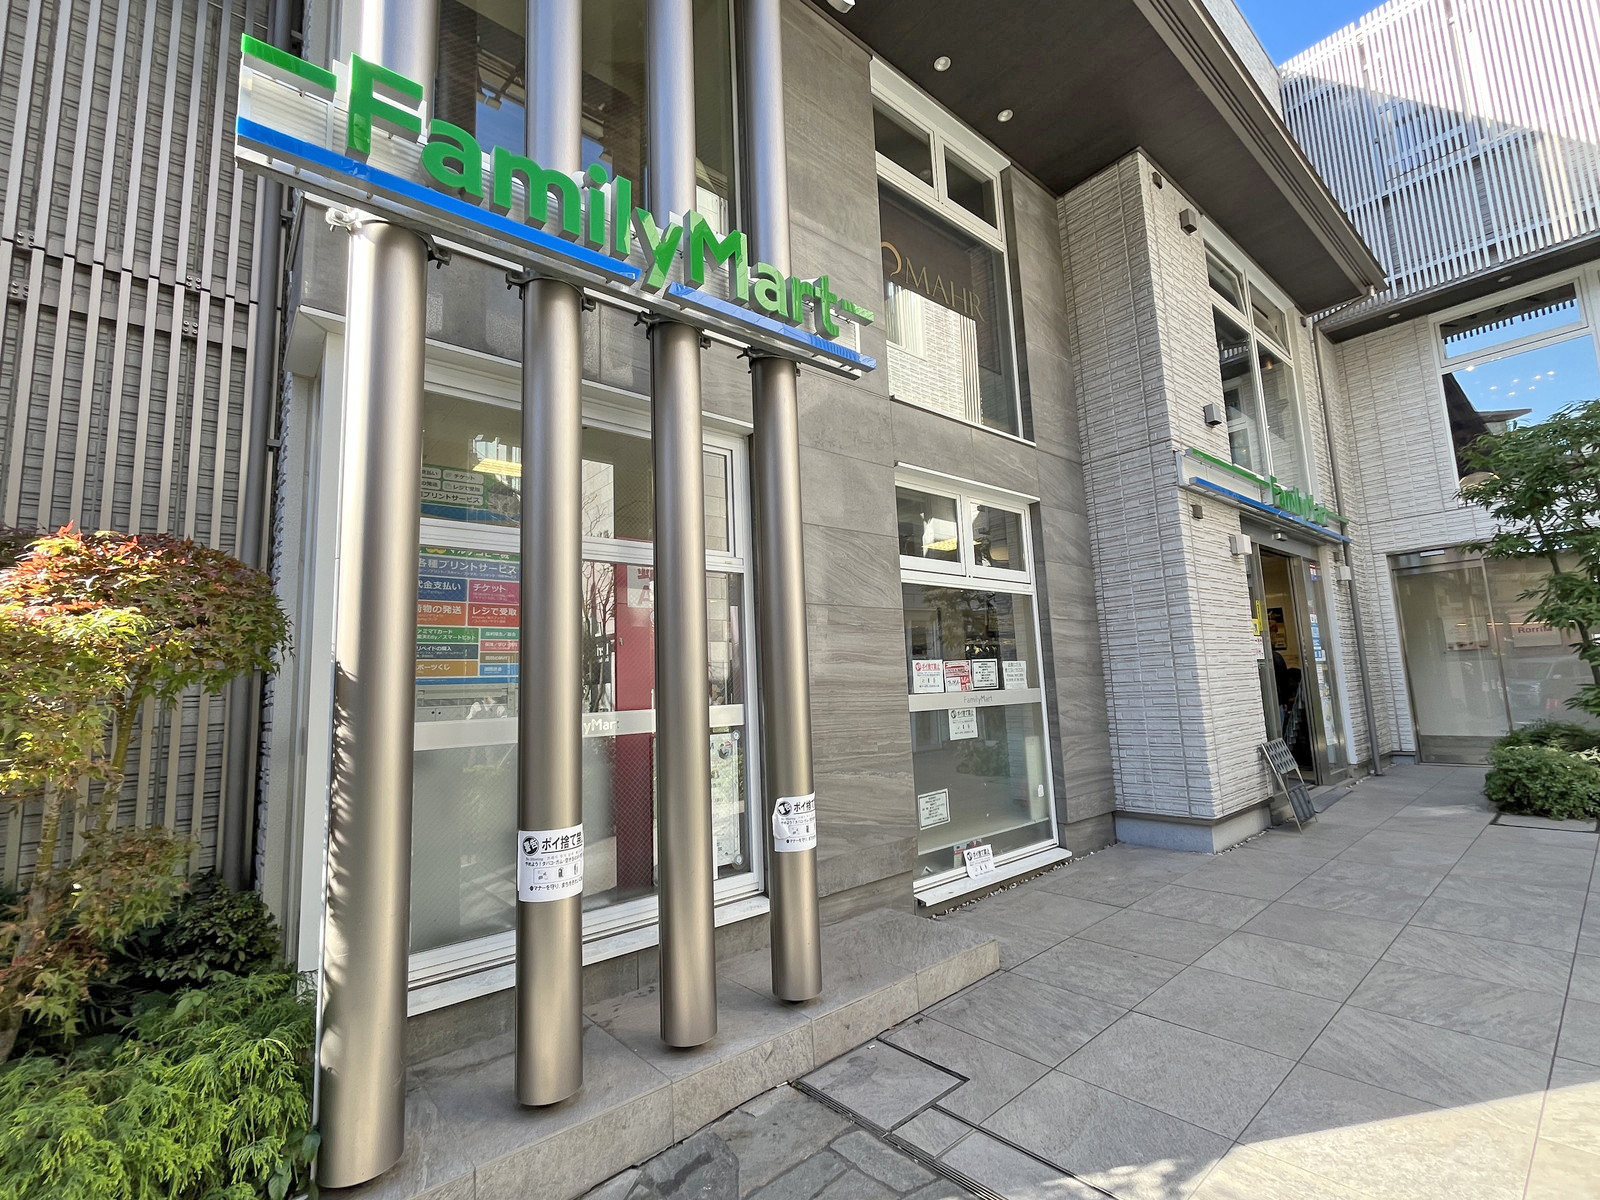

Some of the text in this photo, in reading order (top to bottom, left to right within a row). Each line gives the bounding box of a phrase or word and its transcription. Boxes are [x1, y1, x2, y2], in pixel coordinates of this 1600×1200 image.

[346, 53, 839, 339] FamilyMart
[421, 491, 480, 504] プリントサービス
[473, 583, 506, 593] チケット
[472, 606, 517, 617] レジで受取
[963, 695, 993, 704] FamilyMart
